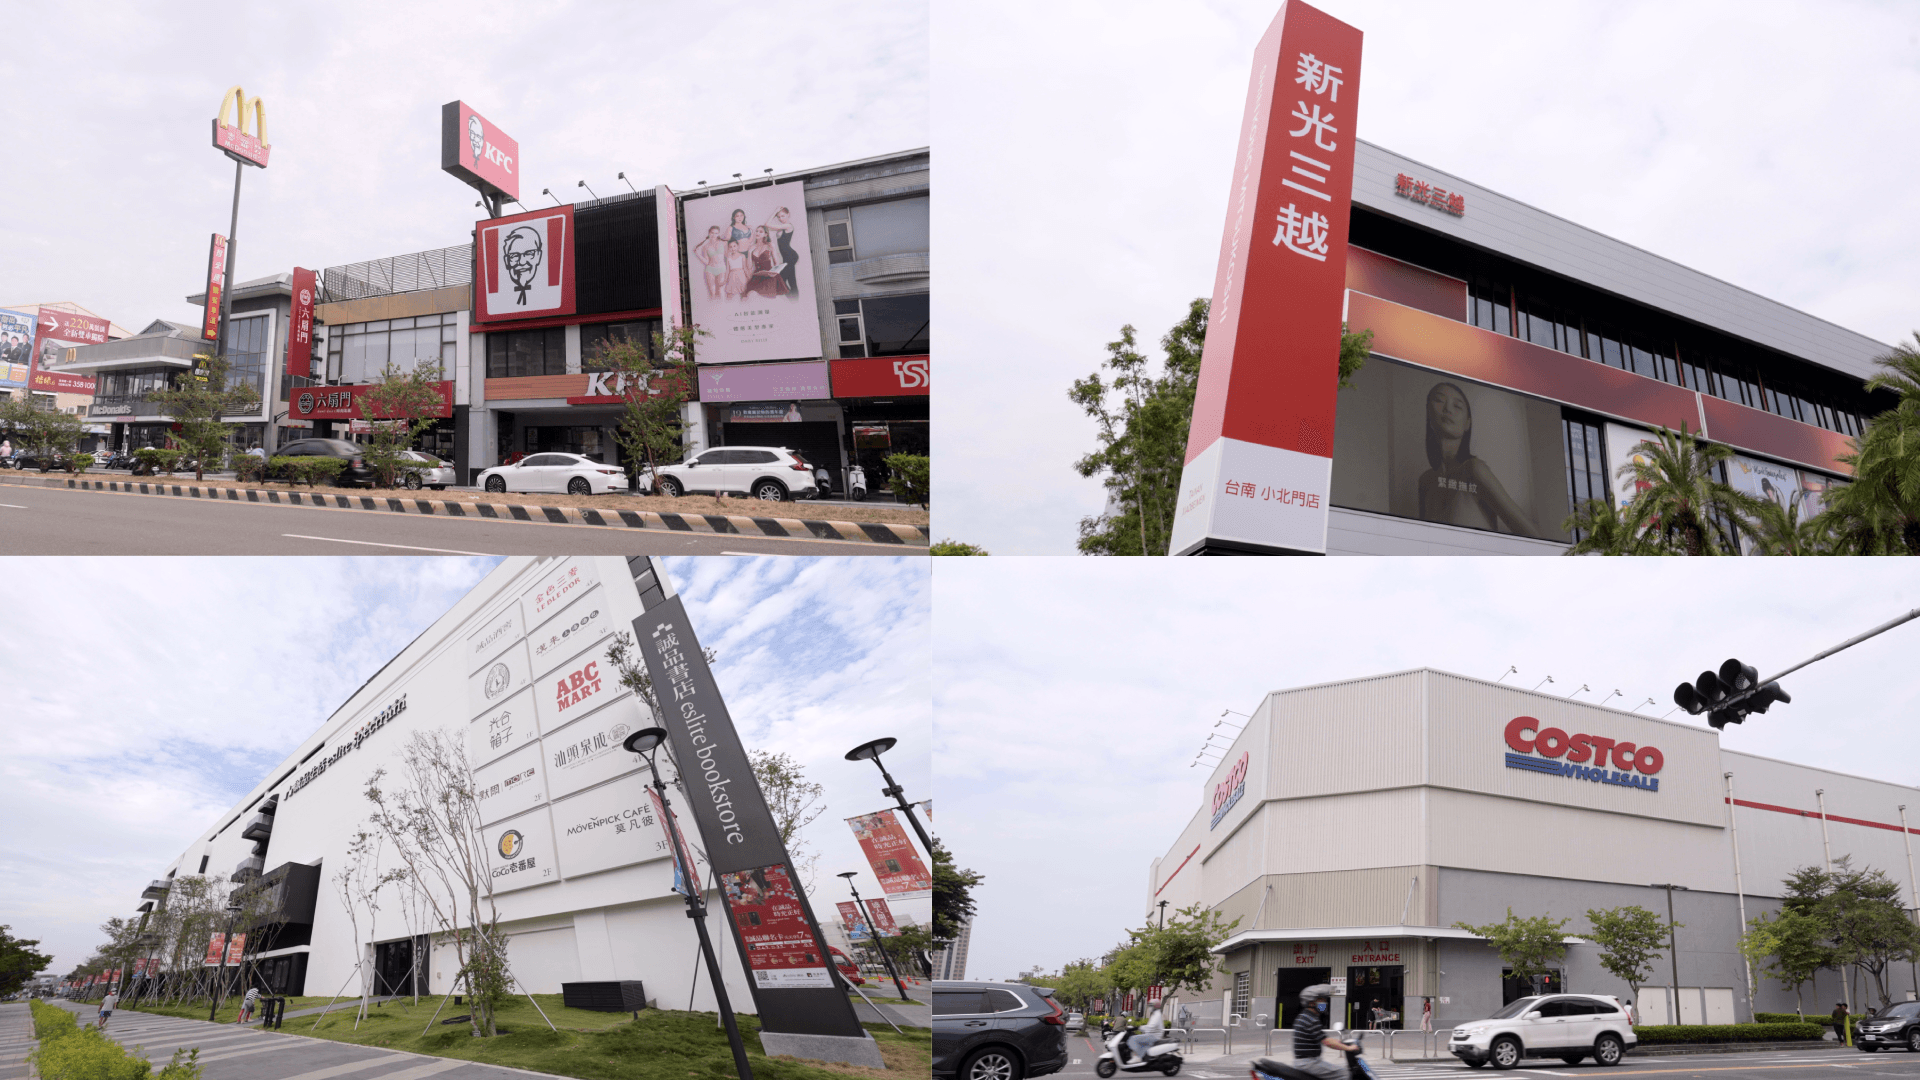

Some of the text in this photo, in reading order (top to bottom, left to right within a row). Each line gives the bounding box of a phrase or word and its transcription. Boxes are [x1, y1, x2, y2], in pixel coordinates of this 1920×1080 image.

[484, 141, 513, 175] KFC
[1273, 51, 1343, 263] 新光三越
[1397, 173, 1465, 211] 新光三越
[317, 391, 352, 409] 六扇門
[584, 370, 664, 397] KFC
[91, 404, 132, 415] McDonald's
[1225, 479, 1320, 509] 台南 小北門店
[556, 660, 599, 700] ABC
[655, 633, 695, 702] 誠品書店
[557, 678, 602, 713] MART
[328, 741, 353, 767] eslite
[353, 692, 407, 750] spectrum
[490, 726, 513, 750] 箱子
[1504, 716, 1664, 775] COSTCO
[554, 731, 608, 768] 汕頭泉成
[680, 702, 744, 845] eslite bookstore
[1211, 751, 1249, 816] COSTCO
[1557, 762, 1659, 792] WHOLESALE
[567, 803, 651, 836] MÖVENPICK CAFÉ
[615, 815, 654, 835] 莫凡彼
[1293, 943, 1318, 954] 出口
[1295, 956, 1314, 964] EXIT
[1352, 953, 1400, 963] ENTRANCE
[1363, 941, 1389, 952] 入口
